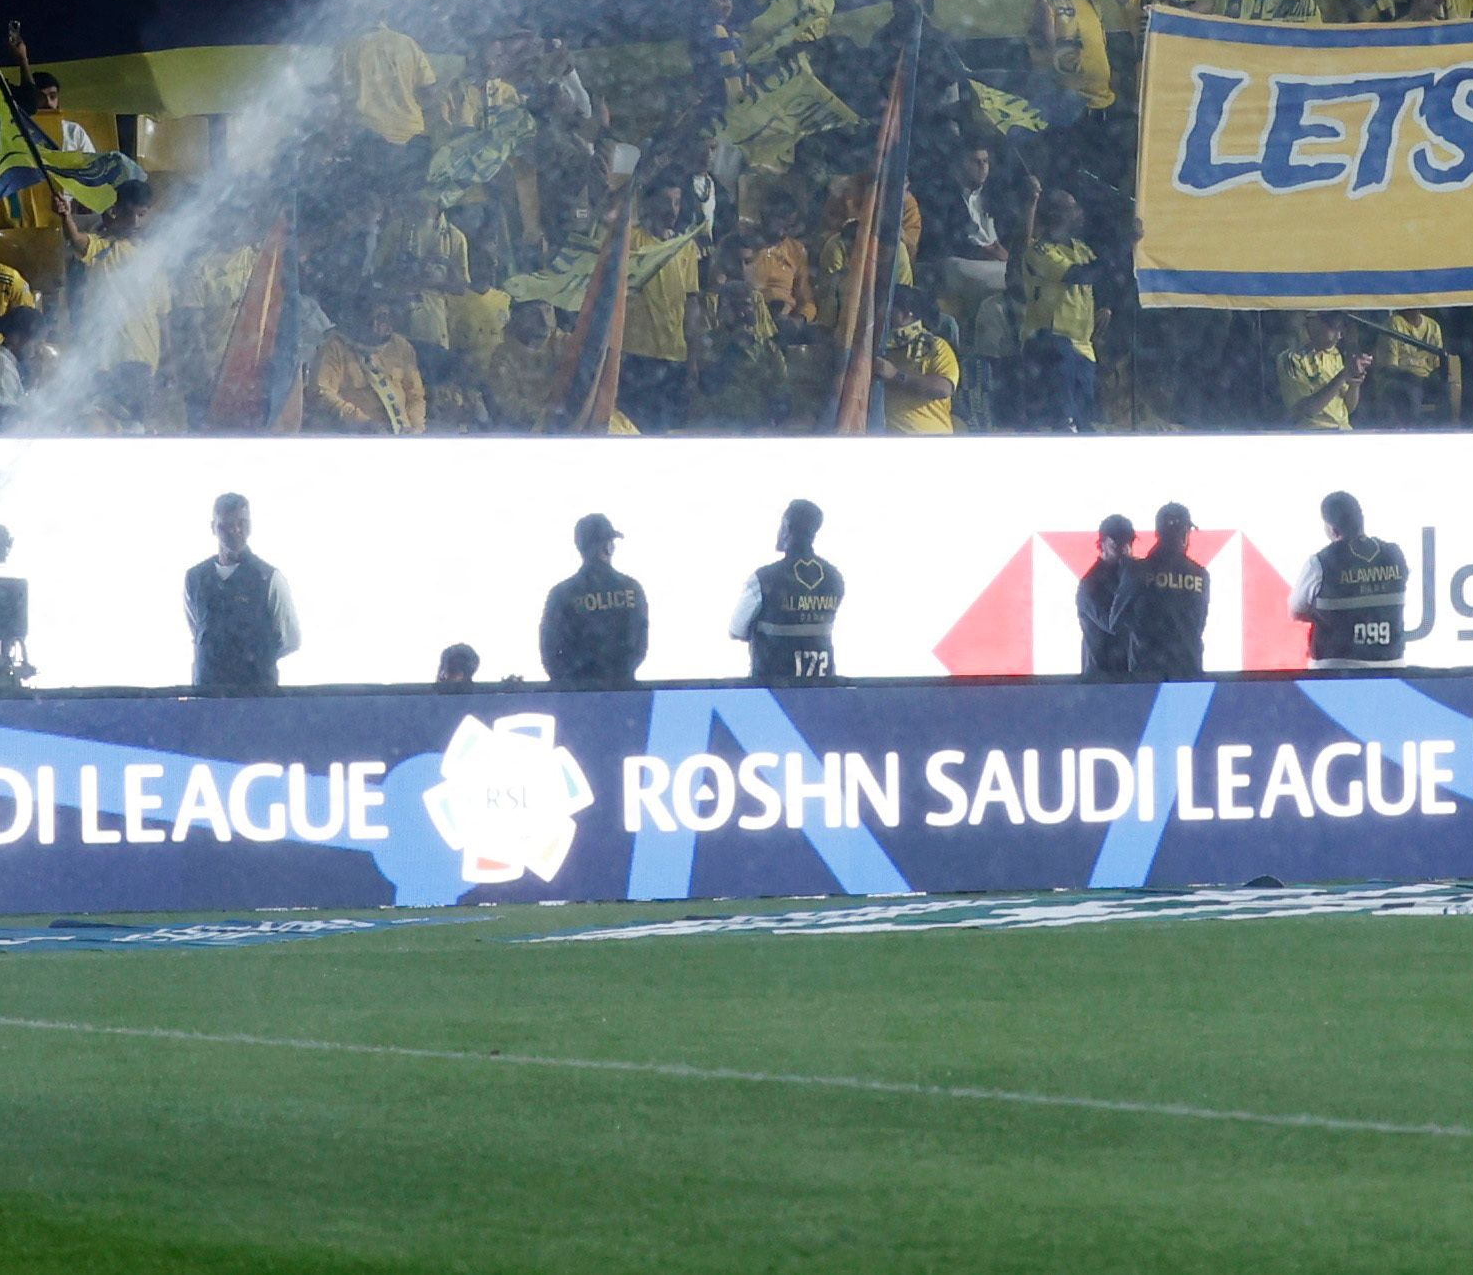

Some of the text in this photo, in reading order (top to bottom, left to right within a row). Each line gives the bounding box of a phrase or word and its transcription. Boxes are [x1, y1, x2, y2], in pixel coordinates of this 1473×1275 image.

[1340, 563, 1401, 586] ALAWWAL
[1353, 621, 1389, 646] 099
[81, 761, 389, 845] LEAGUE
[623, 739, 1457, 835] ROSHN SAUDI LEAGUE
